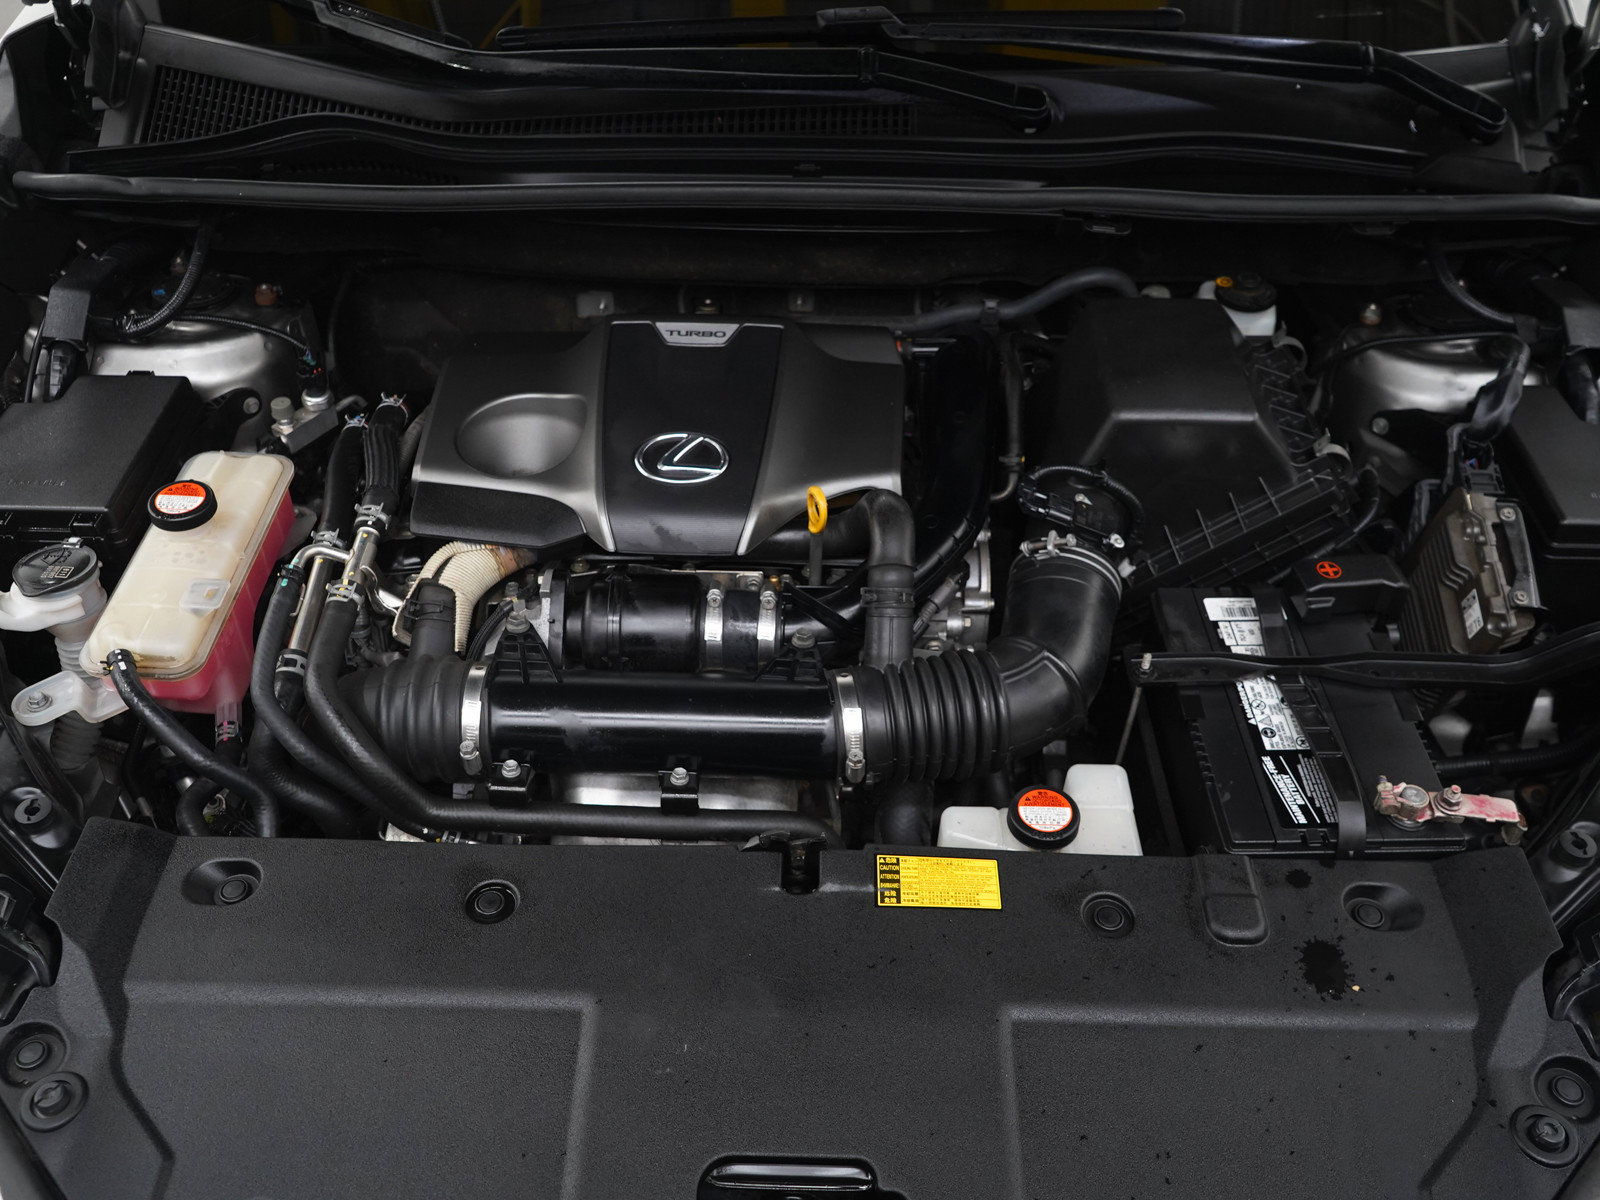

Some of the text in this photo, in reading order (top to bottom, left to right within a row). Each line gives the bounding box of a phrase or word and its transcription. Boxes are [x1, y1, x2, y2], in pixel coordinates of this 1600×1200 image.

[665, 329, 727, 338] TURBO
[1261, 755, 1308, 824] MAINTENANCE-FREE
[1281, 773, 1306, 805] BATTERY
